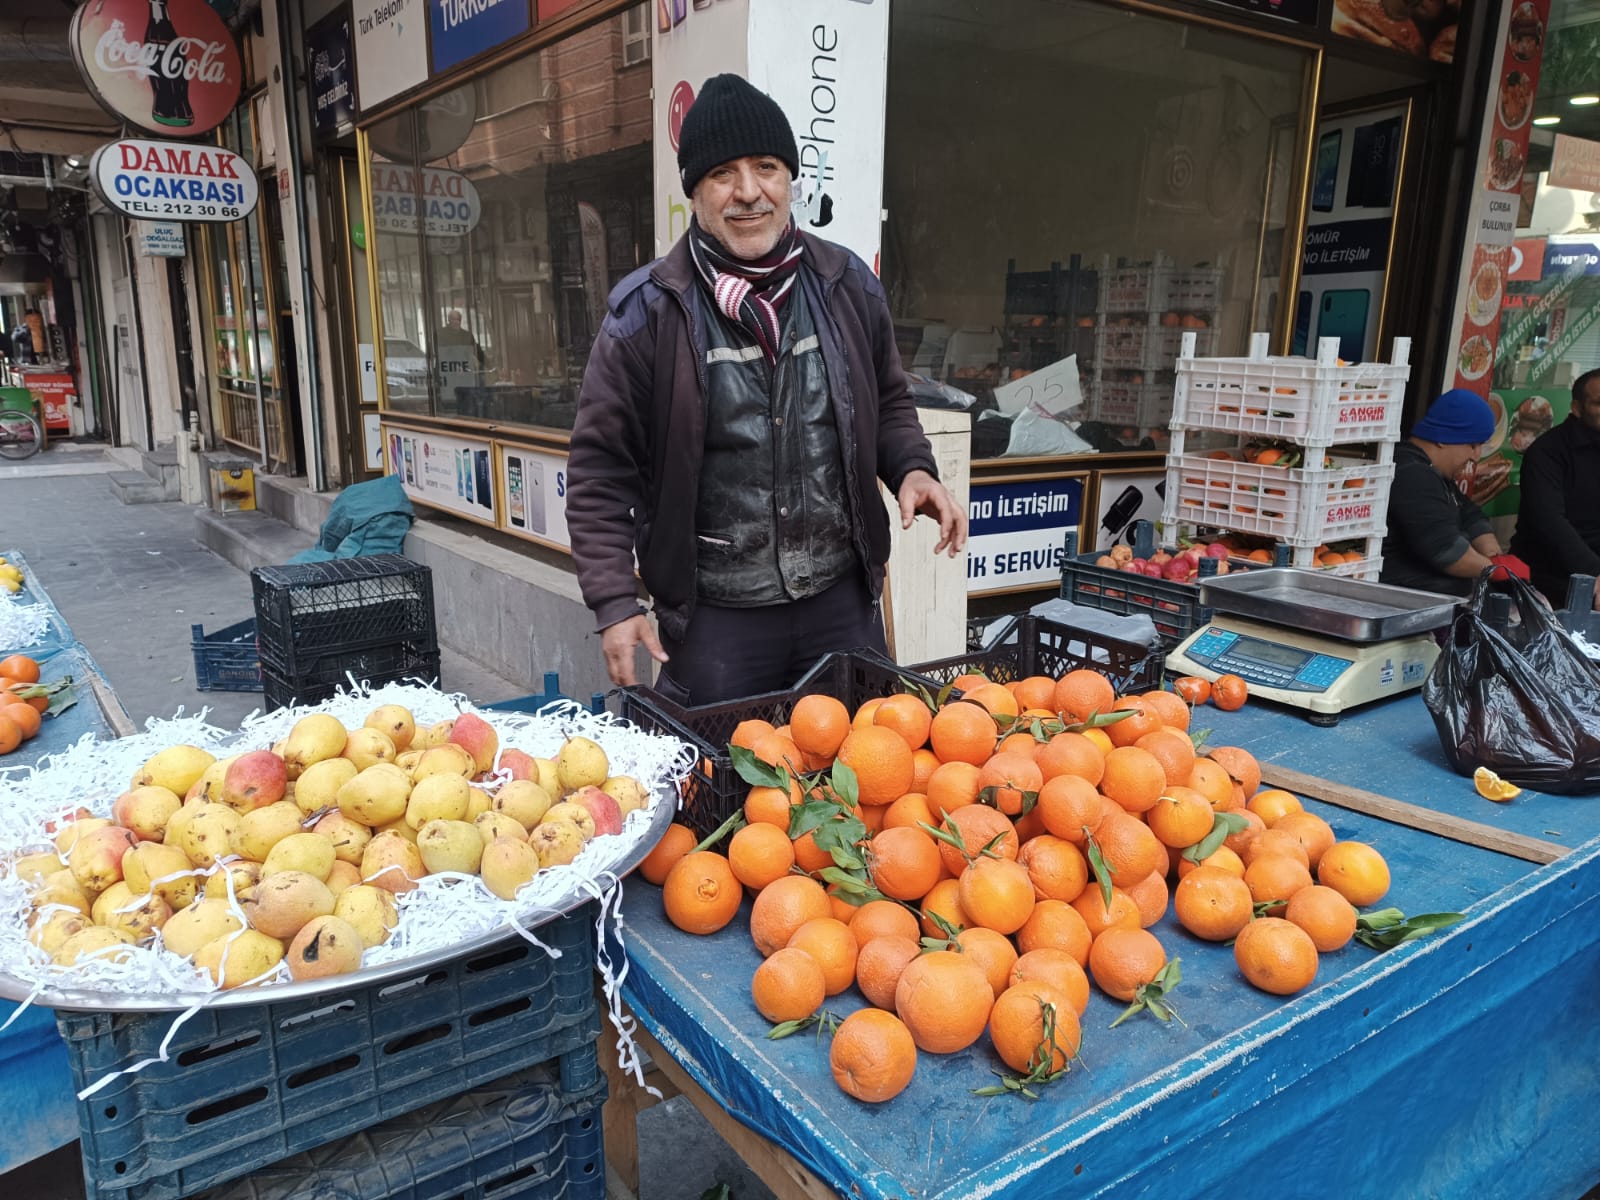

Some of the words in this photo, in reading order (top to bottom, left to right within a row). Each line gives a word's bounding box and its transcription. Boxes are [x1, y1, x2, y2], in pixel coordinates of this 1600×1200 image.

[800, 24, 837, 180] iPhone
[118, 144, 239, 179] DAMAK
[114, 174, 244, 206] OCAKBAŞI
[121, 200, 158, 212] TEL:
[163, 203, 193, 215] 212
[198, 205, 216, 216] 30
[221, 207, 240, 217] 66
[998, 490, 1069, 518] İLETİŞİM
